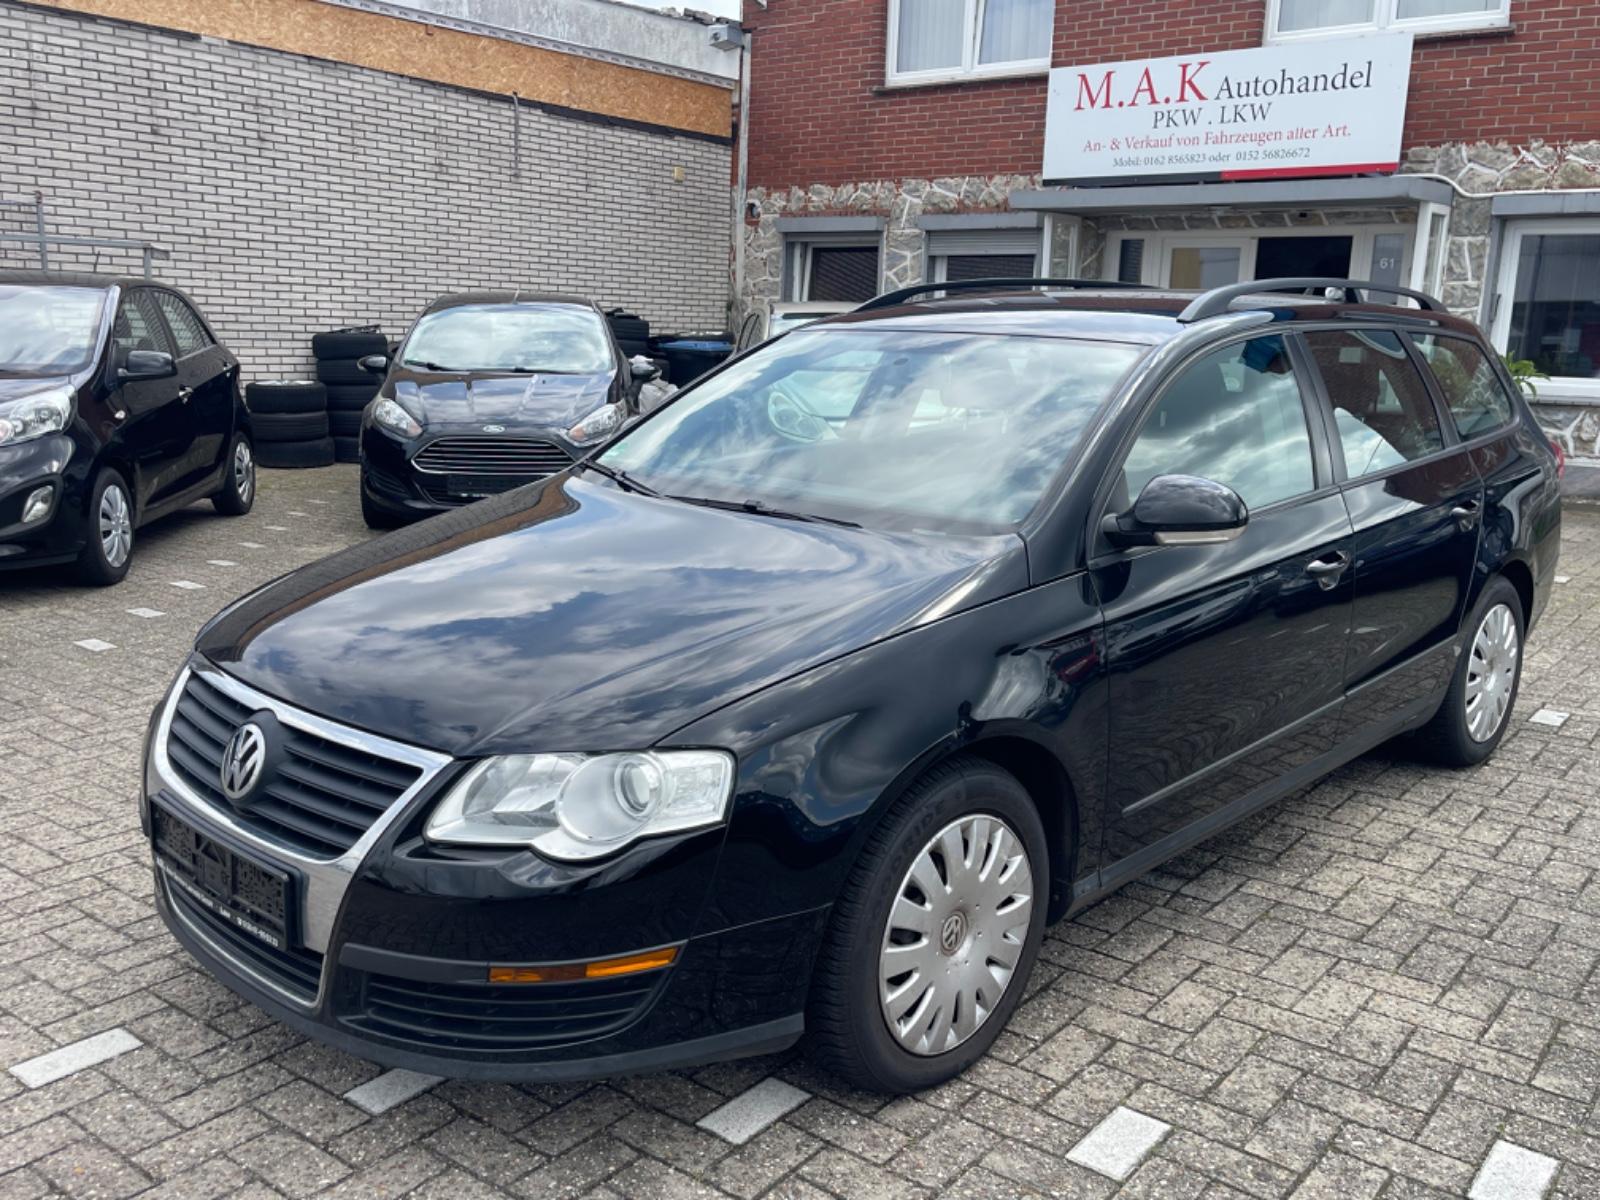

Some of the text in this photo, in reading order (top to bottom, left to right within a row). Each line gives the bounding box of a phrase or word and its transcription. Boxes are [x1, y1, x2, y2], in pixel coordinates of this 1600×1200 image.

[1074, 60, 1373, 110] M.A.K Autohandel
[1152, 107, 1203, 129] PKW
[1219, 102, 1272, 125] LKW
[1083, 123, 1351, 153] An- & Verkauf von Fahrzeugen aller Art.
[1112, 155, 1142, 168] Mobil:
[1143, 154, 1165, 167] 0162
[1208, 151, 1231, 163] oder
[1235, 149, 1260, 162] 0152
[1262, 147, 1311, 160] 56826672
[1379, 258, 1395, 270] 61
